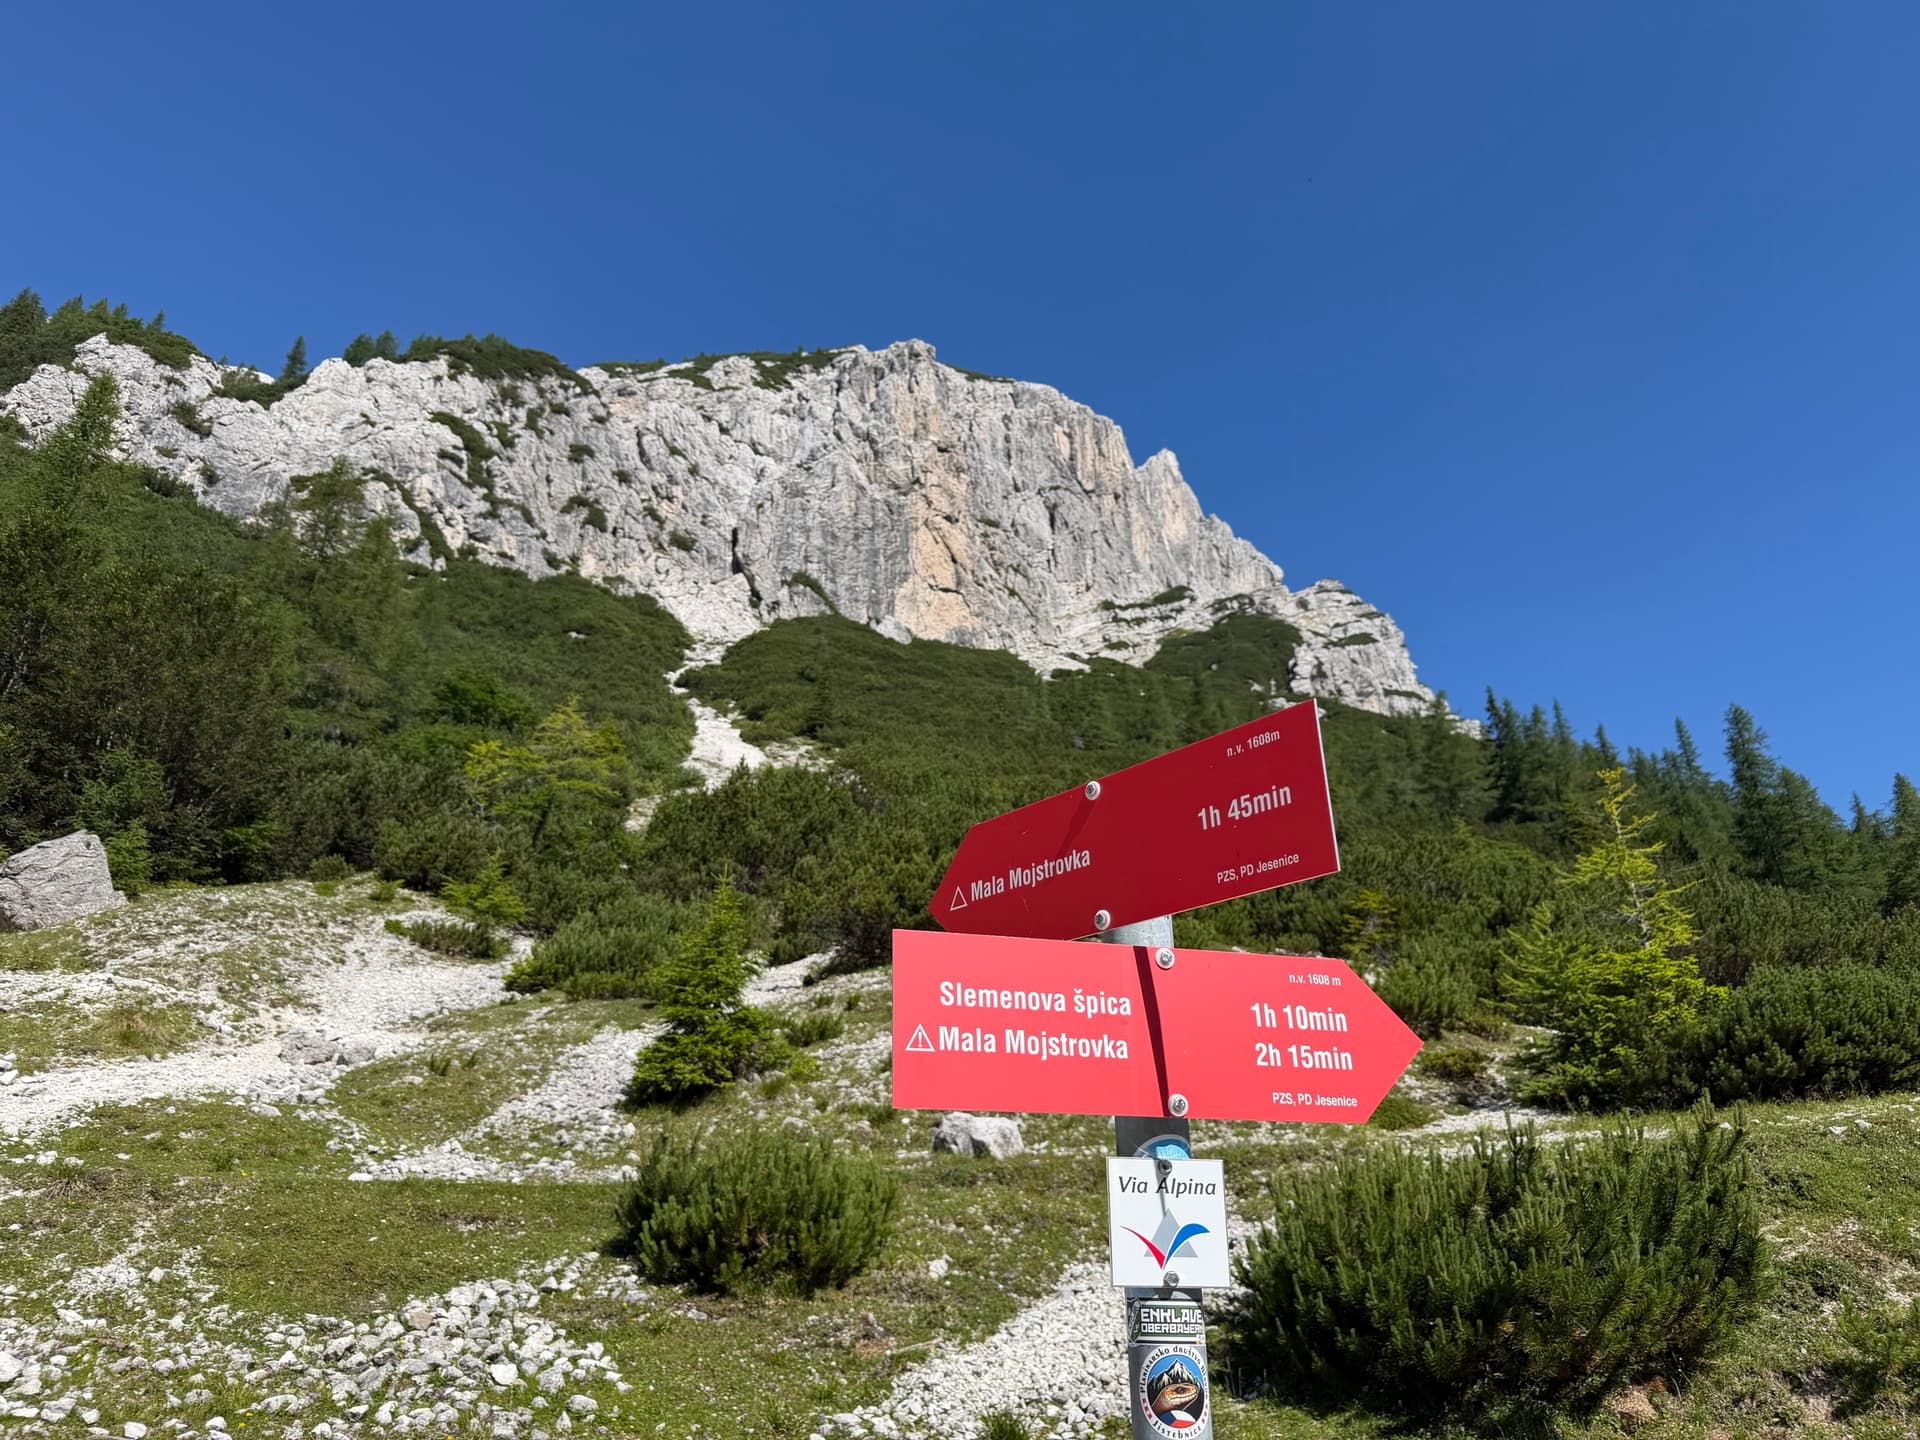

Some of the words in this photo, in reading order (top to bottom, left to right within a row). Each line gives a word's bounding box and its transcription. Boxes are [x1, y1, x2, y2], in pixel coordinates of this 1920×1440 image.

[1248, 729, 1281, 750] 1608m
[1198, 806, 1221, 831] 1h
[1227, 785, 1292, 821] 45min
[970, 876, 1005, 902] Mala
[1010, 848, 1091, 889] Mojstrovka
[1216, 869, 1239, 885] PZS,
[1240, 864, 1254, 879] PD
[1256, 852, 1300, 873] Jesenice
[1289, 975, 1306, 985] n.v.
[1308, 973, 1329, 986] 1608
[1332, 977, 1342, 987] m
[940, 981, 1067, 1013] Slemenova
[1073, 986, 1131, 1020] špica
[1250, 1003, 1277, 1028] 1h
[1281, 1004, 1348, 1033] 10min
[938, 1025, 997, 1054] Mala
[1004, 1028, 1129, 1061] Mojstrovka
[1254, 1042, 1281, 1067] 2h
[1287, 1044, 1353, 1071] 15min
[1272, 1092, 1296, 1107] PZS,
[1298, 1093, 1313, 1106] PD
[1314, 1094, 1358, 1108] Jesenice
[1118, 1176, 1148, 1194] Via
[1156, 1176, 1216, 1198] Alpina
[1140, 1308, 1202, 1323] ENKLAVE
